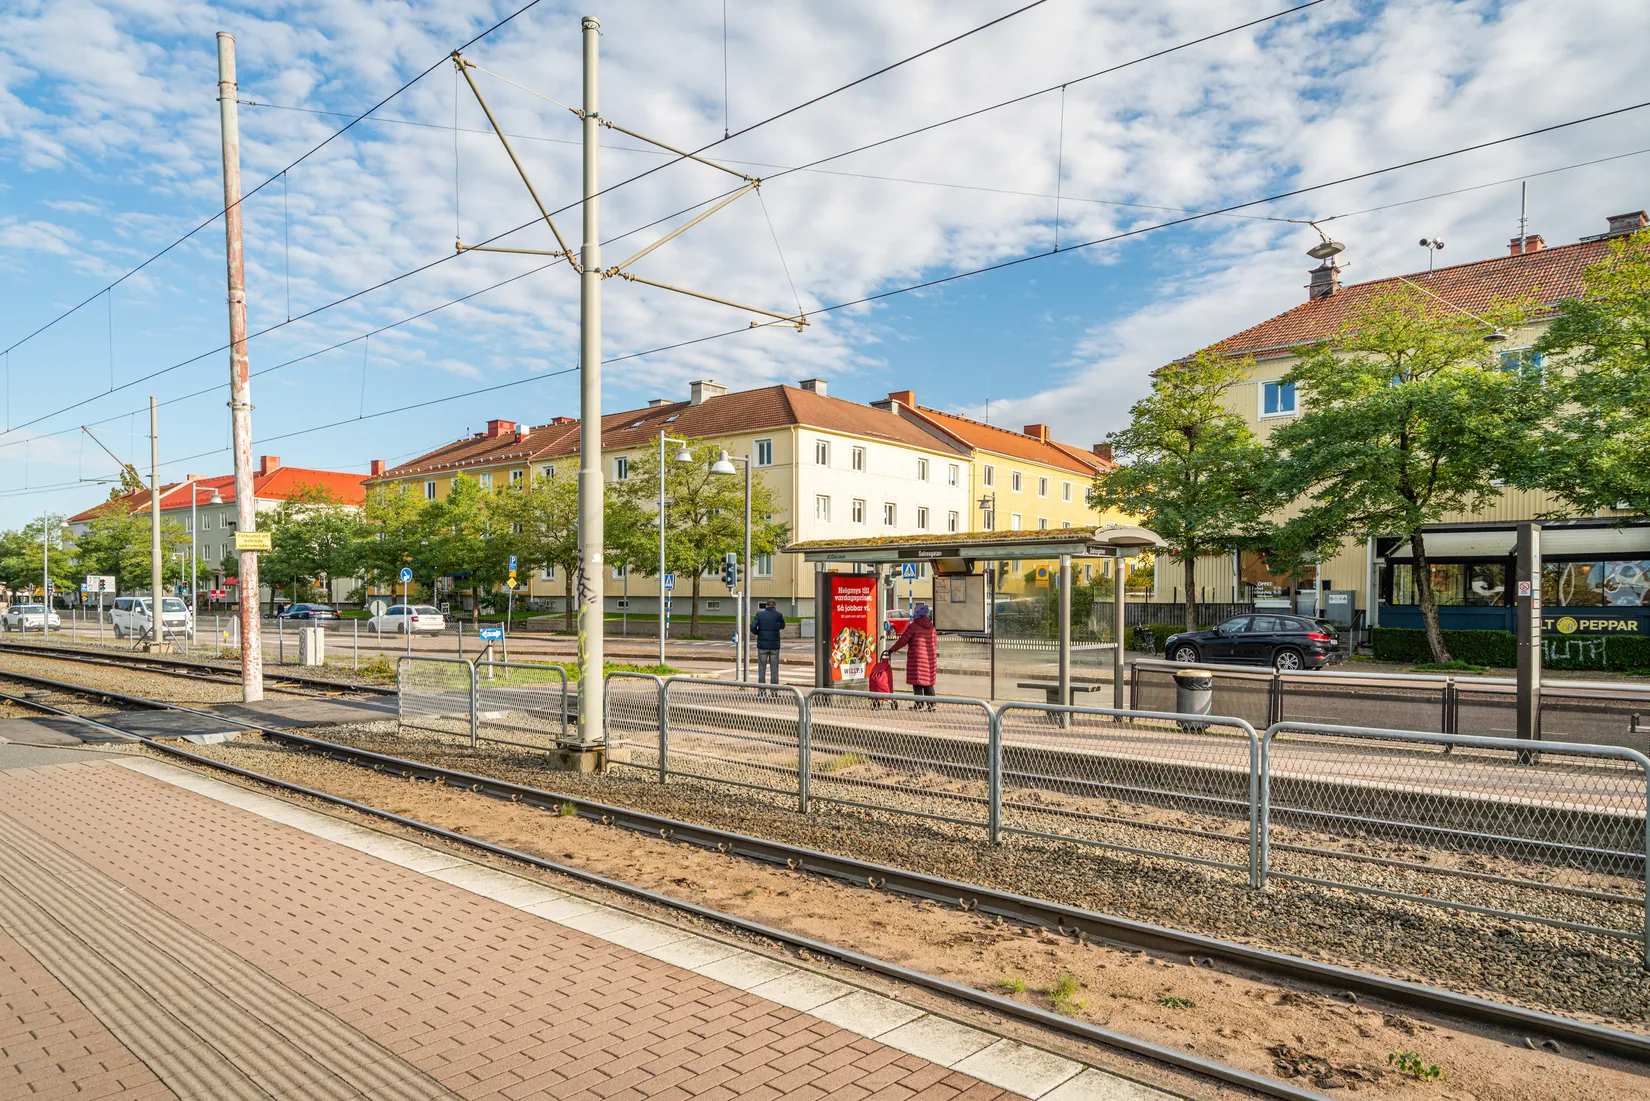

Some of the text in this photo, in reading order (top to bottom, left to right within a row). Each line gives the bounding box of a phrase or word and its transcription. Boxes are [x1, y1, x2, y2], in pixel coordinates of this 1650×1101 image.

[838, 586, 862, 594] Helgmys
[844, 604, 863, 612] jobbar
[1580, 620, 1638, 630] PEPPAR
